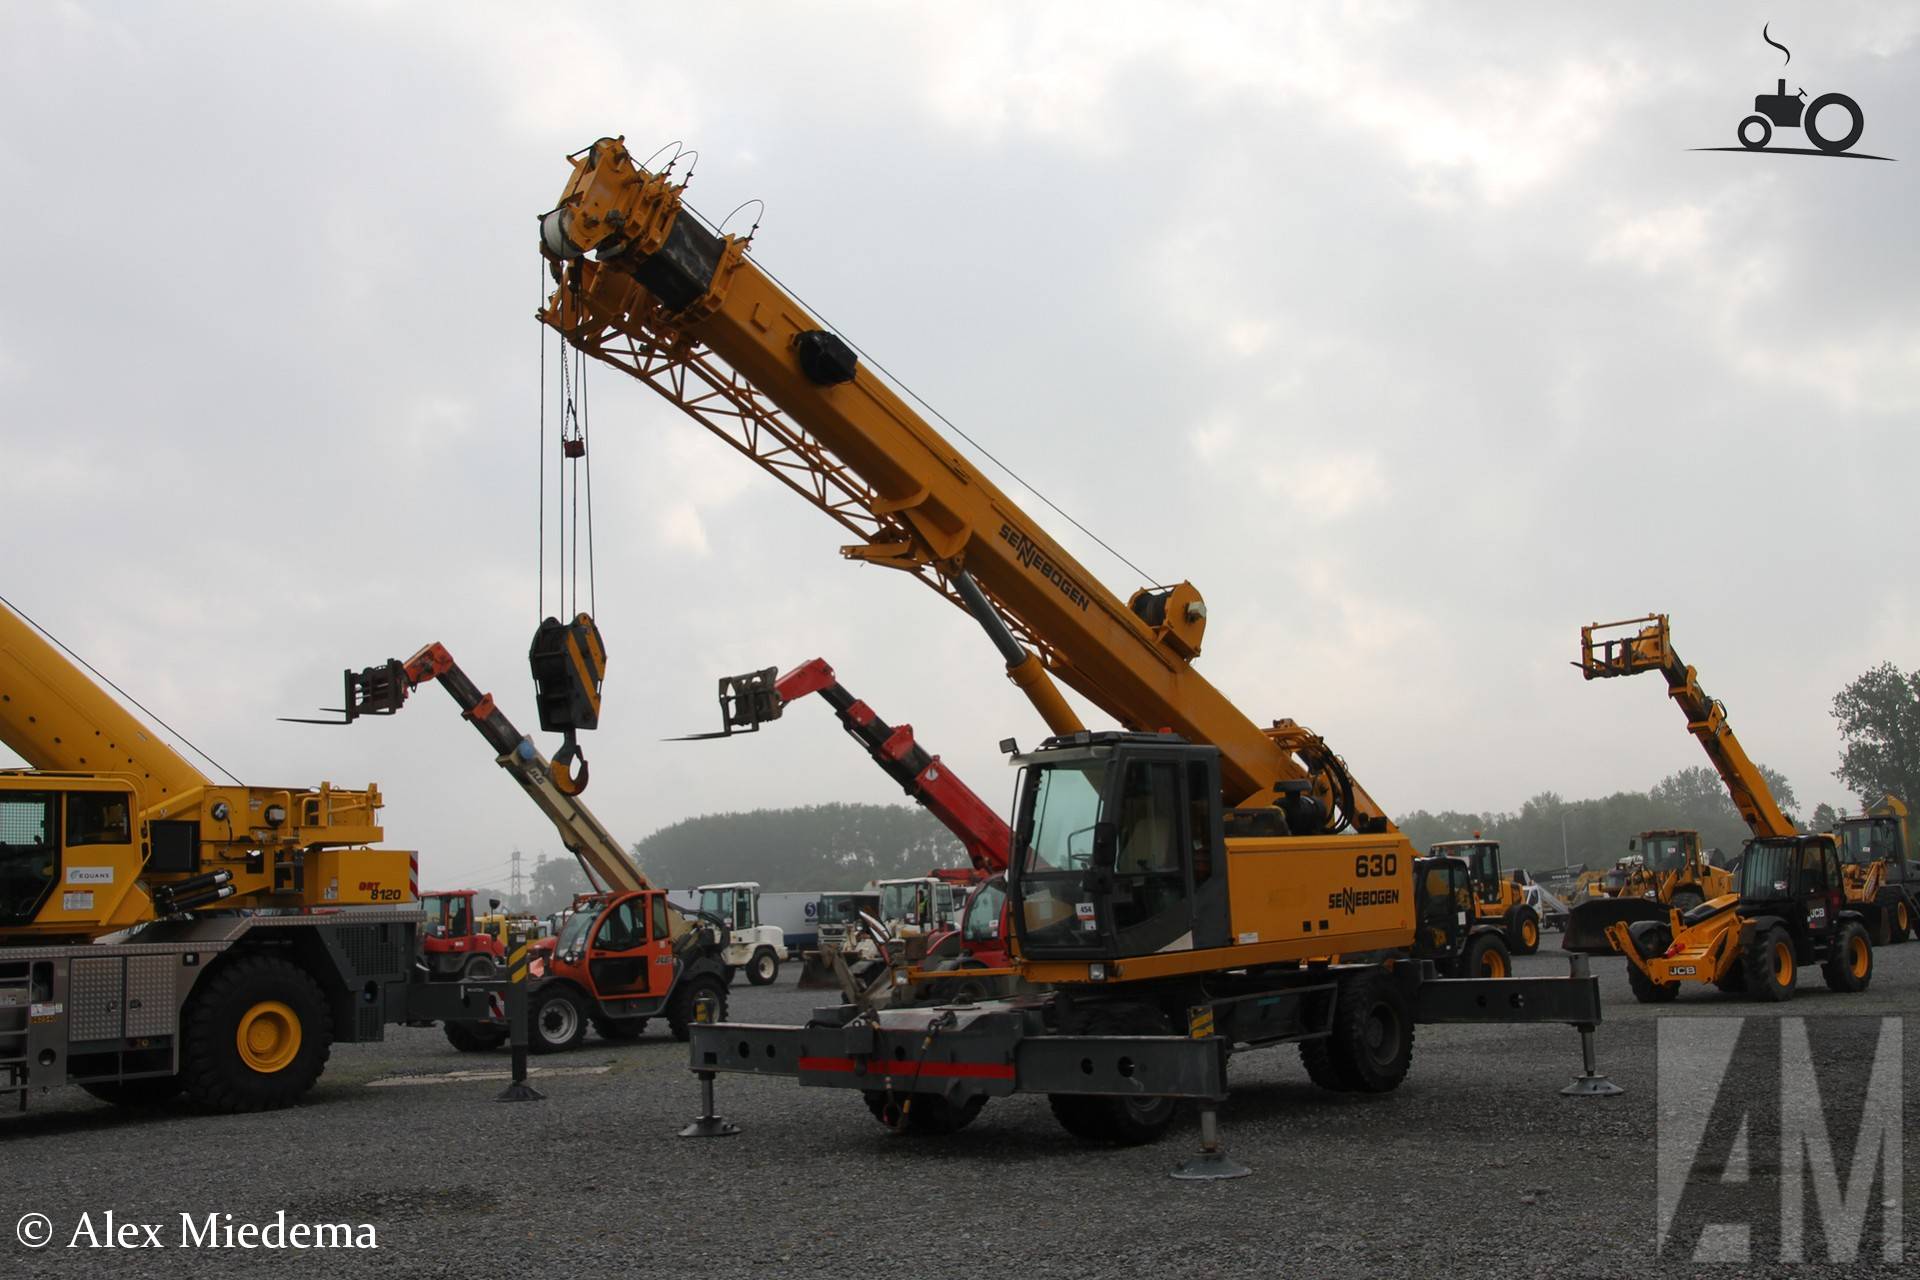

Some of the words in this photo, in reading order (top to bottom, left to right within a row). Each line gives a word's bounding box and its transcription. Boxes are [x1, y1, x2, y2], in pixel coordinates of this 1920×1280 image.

[999, 523, 1090, 612] SENNEBOGEN
[1355, 853, 1397, 878] 630
[370, 889, 402, 900] 8120
[1328, 887, 1399, 915] SENNEBOGEN
[1810, 907, 1825, 919] JCB
[1670, 966, 1697, 976] JCB
